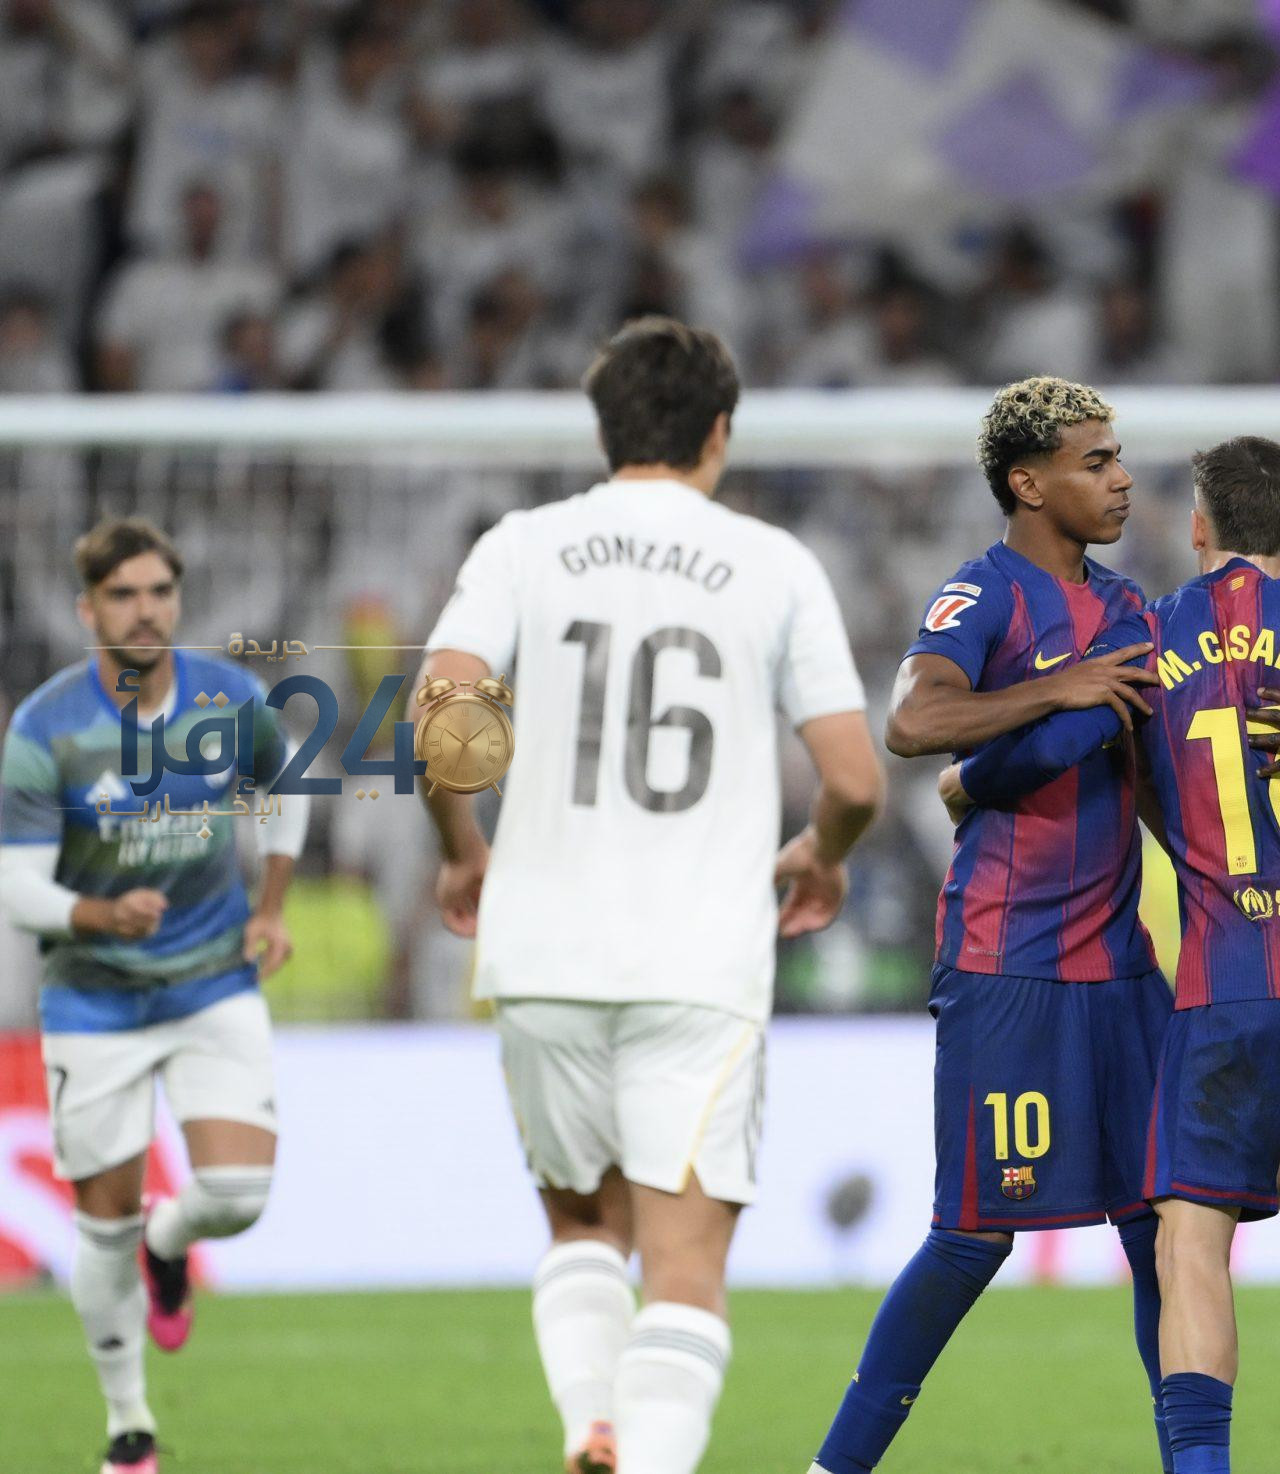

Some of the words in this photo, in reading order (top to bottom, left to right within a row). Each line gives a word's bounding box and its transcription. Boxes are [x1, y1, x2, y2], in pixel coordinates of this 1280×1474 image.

[560, 535, 733, 594] GONZALO
[1157, 649, 1202, 691] M.
[562, 620, 722, 813] 16
[984, 1091, 1050, 1160] 10
